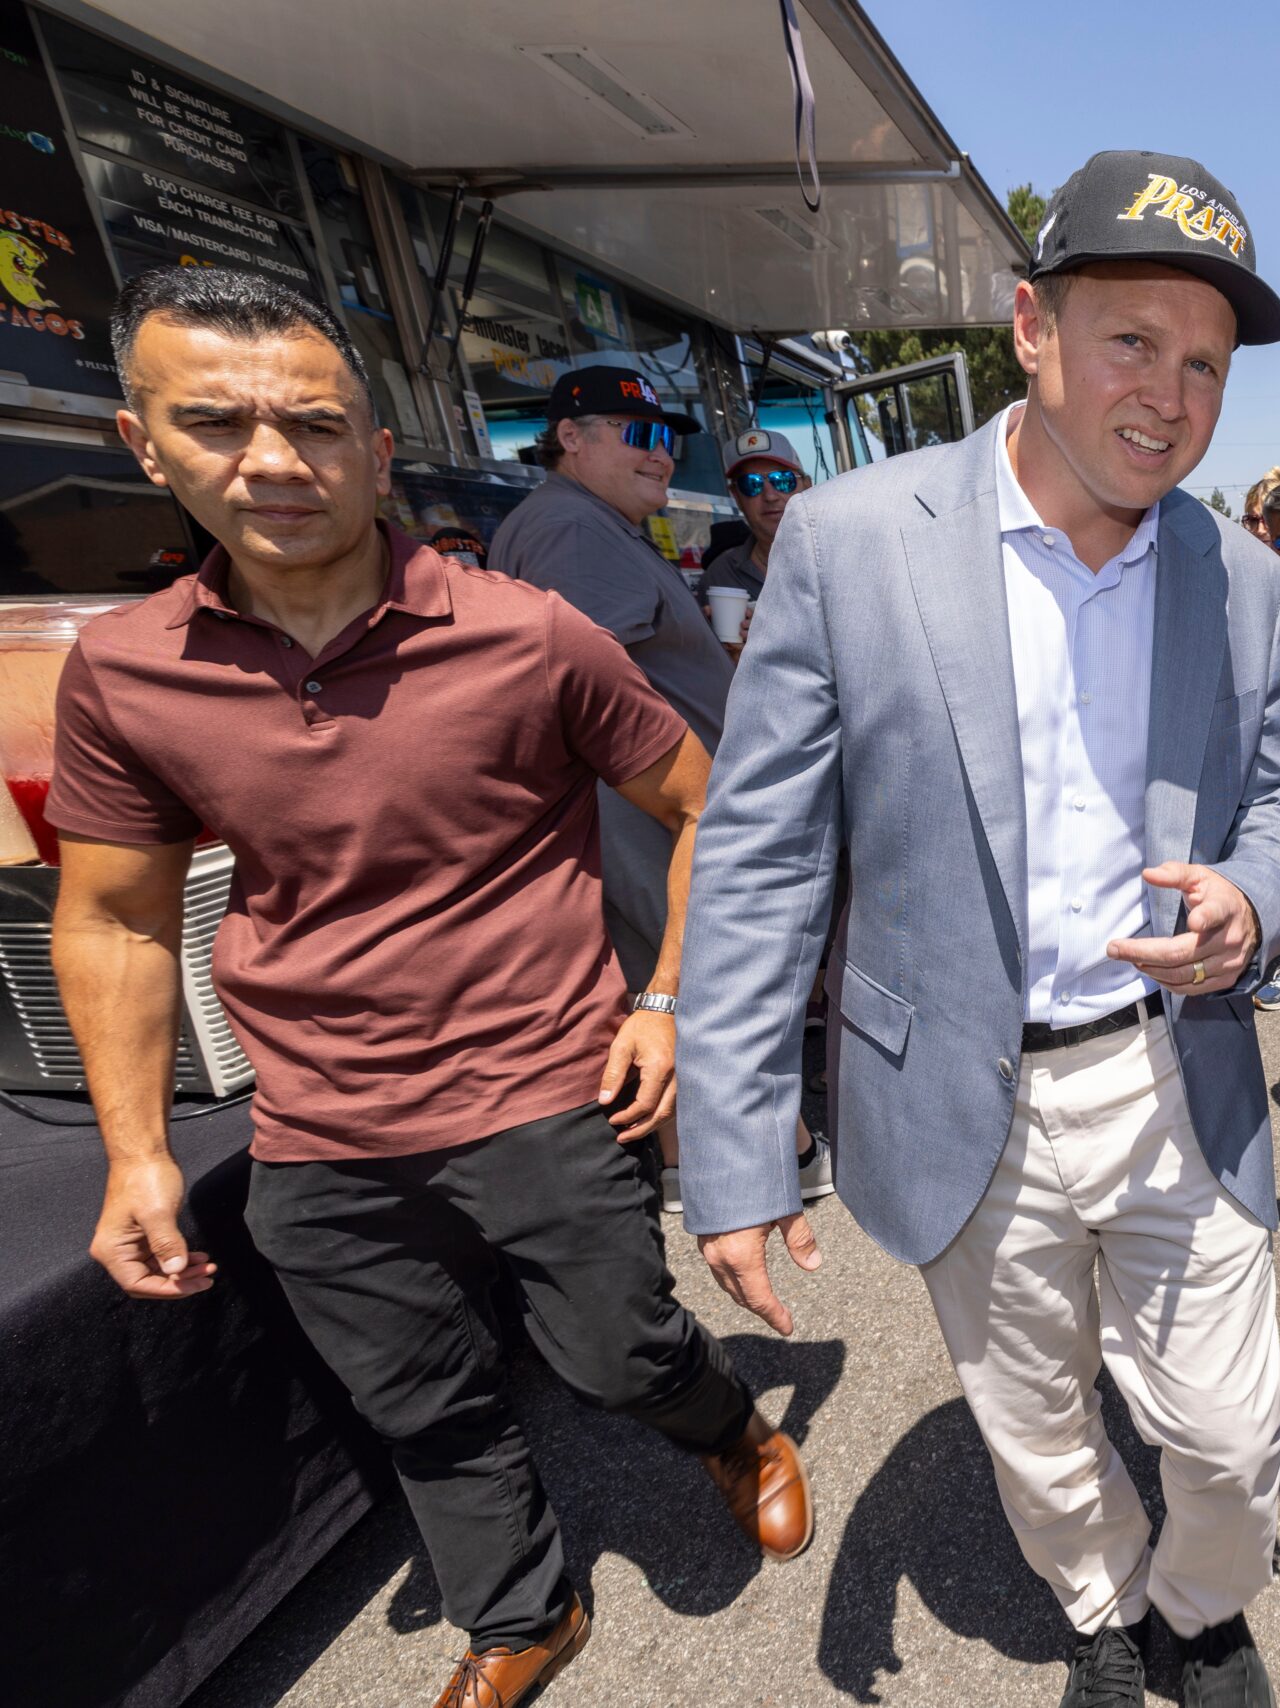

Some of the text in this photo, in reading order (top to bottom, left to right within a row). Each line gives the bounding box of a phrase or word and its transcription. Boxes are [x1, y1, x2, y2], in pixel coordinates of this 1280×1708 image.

[128, 85, 244, 144] WILL BE REQUIRED
[131, 69, 146, 84] ID
[165, 85, 232, 123] SIGNATURE
[136, 107, 248, 162] FOR CREDIT CARD
[163, 136, 236, 174] PURCHASES
[158, 196, 194, 217] EACH
[180, 186, 229, 214] CHARGE
[232, 205, 254, 222] FEE
[256, 213, 279, 231] FOR
[1116, 173, 1246, 259] PRATT
[1179, 183, 1207, 200] LOS
